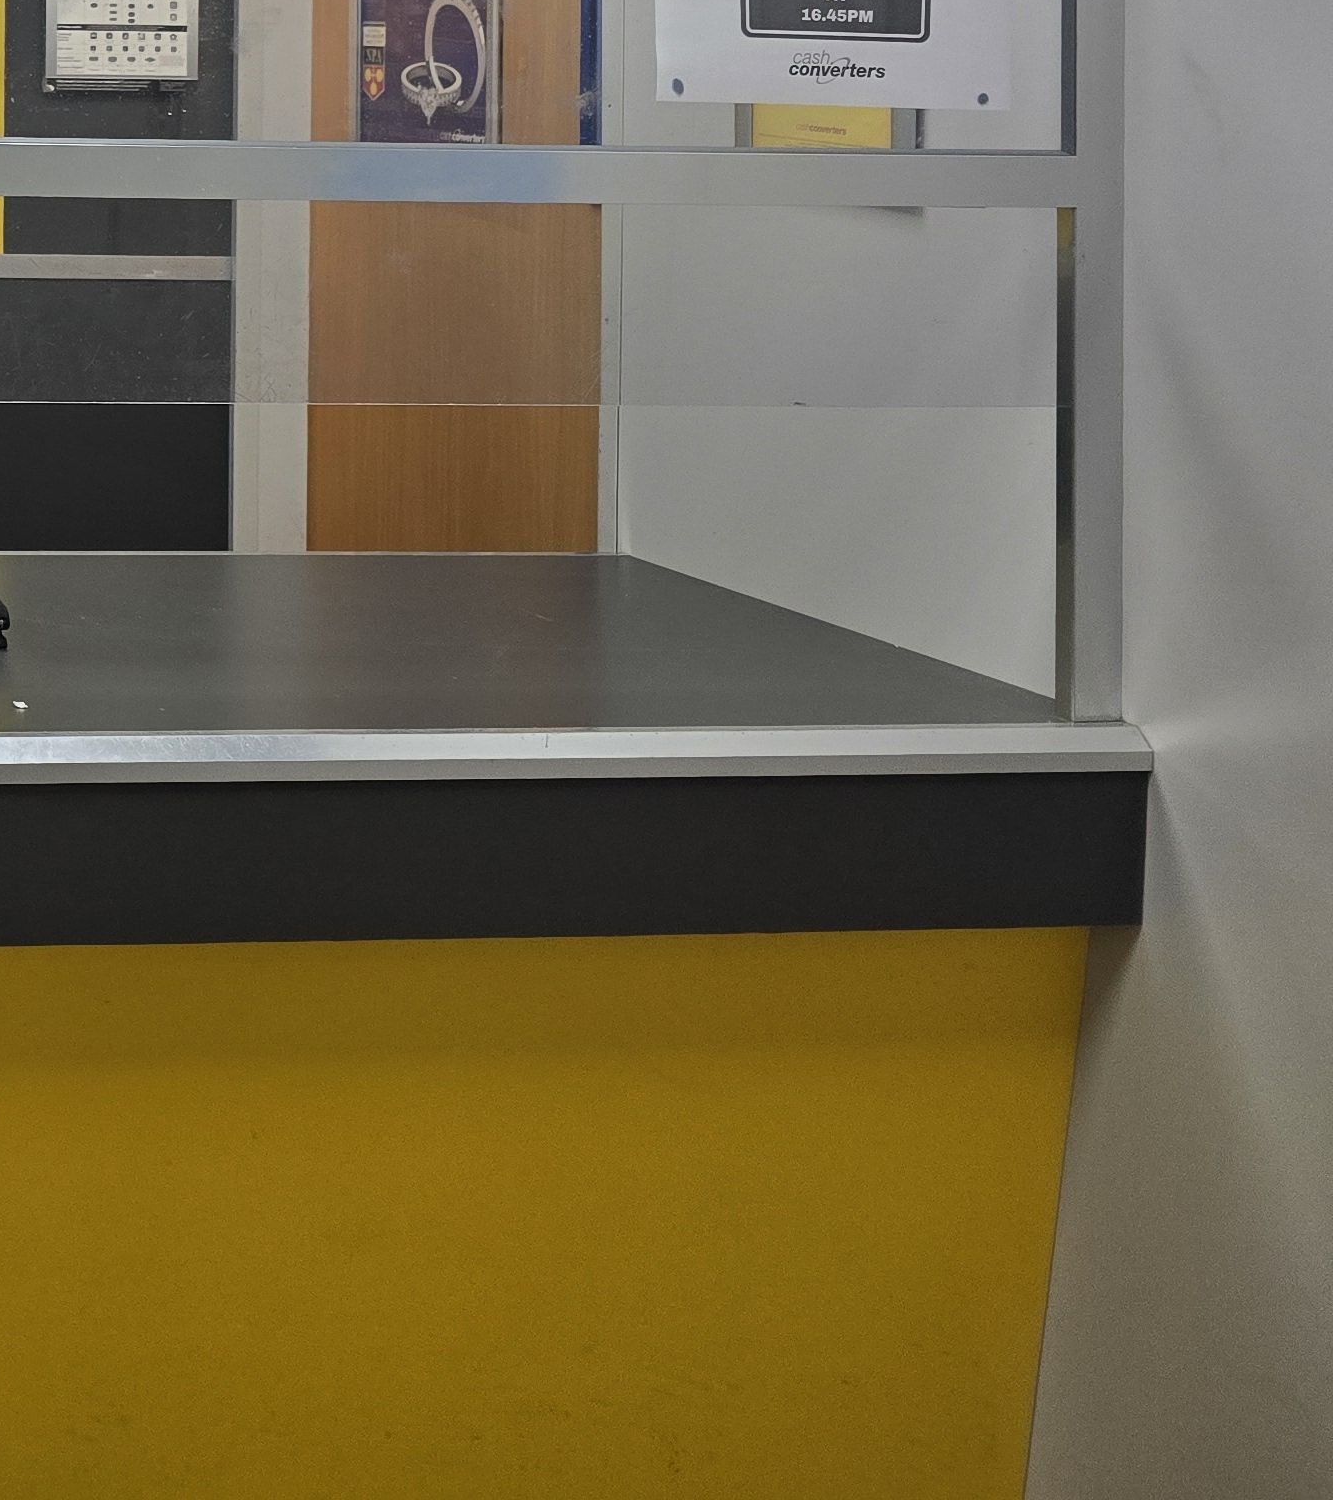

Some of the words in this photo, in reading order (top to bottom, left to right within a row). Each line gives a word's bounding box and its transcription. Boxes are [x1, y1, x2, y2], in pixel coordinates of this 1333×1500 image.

[802, 8, 874, 22] 16.45PM
[793, 50, 831, 64] cash
[789, 62, 885, 80] converters
